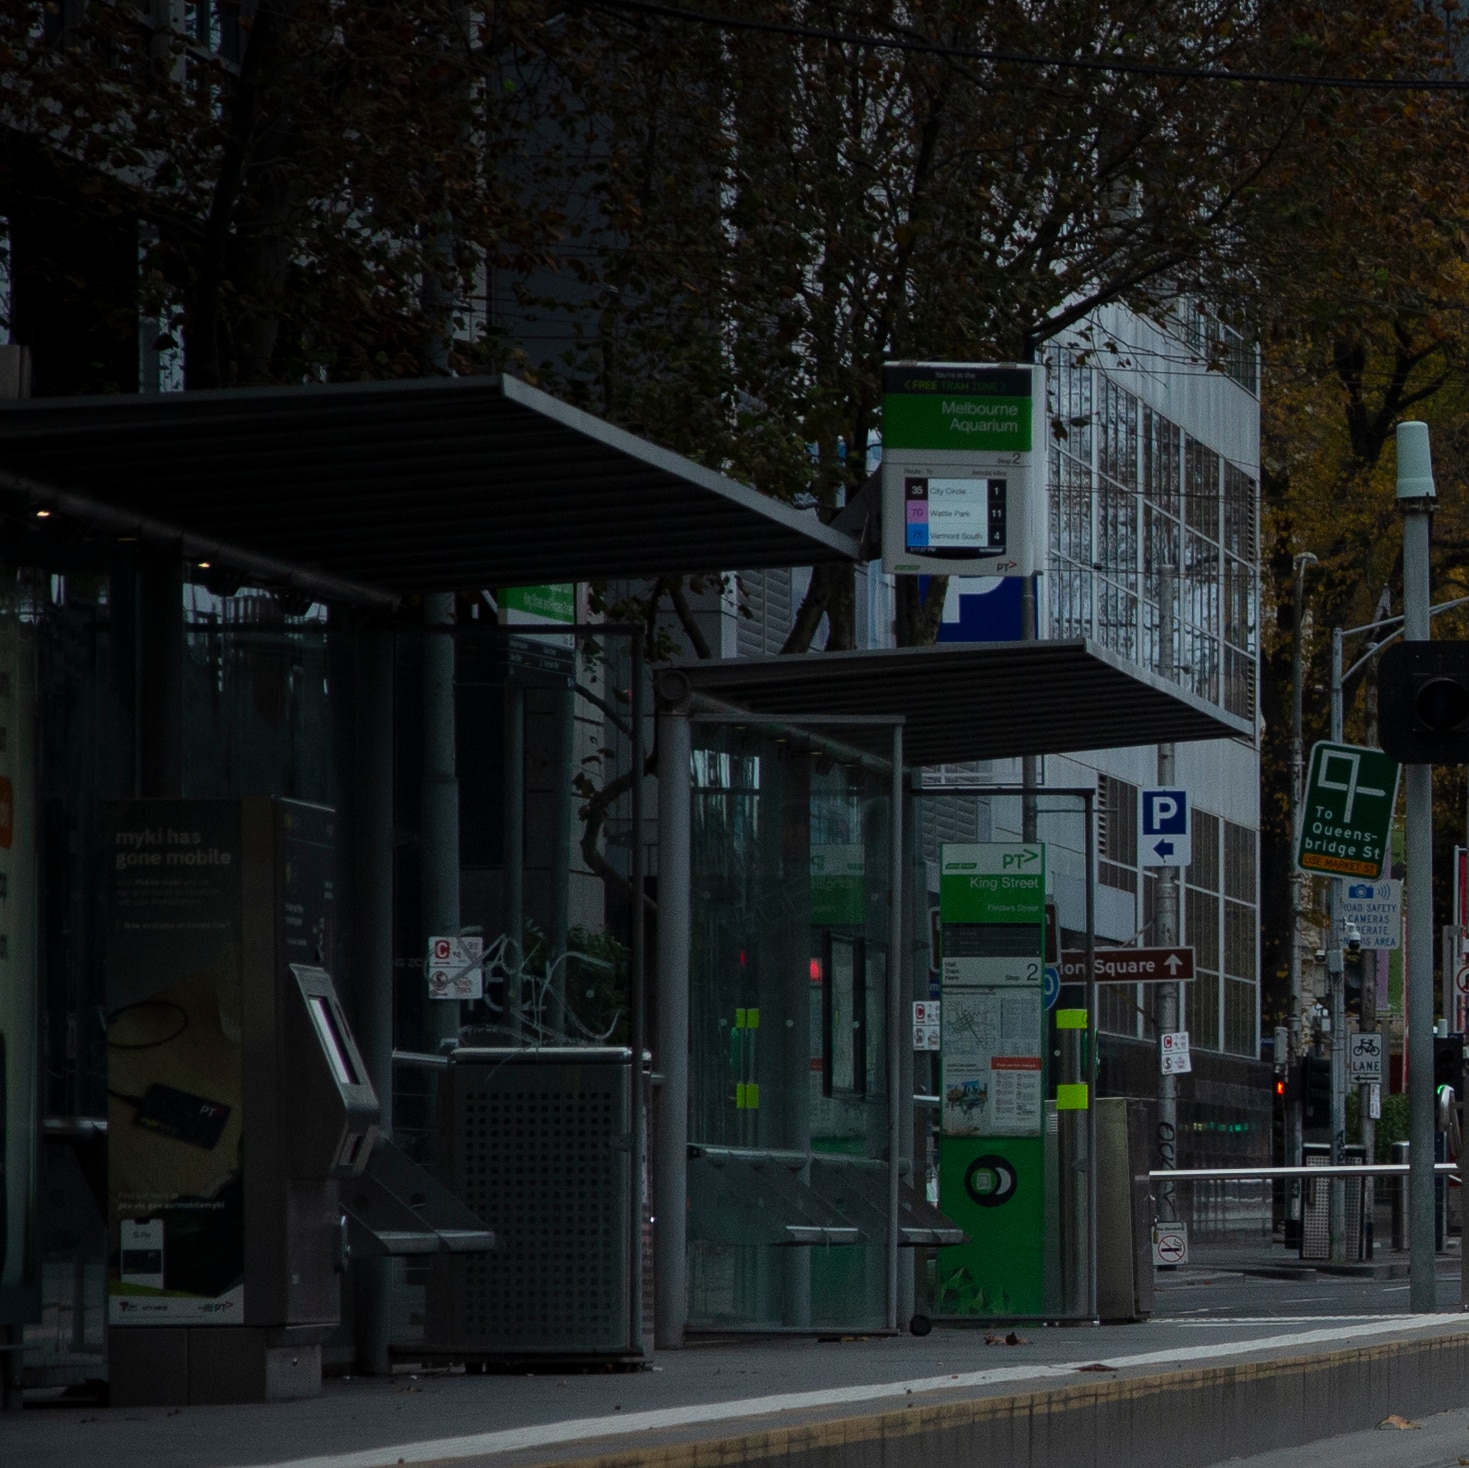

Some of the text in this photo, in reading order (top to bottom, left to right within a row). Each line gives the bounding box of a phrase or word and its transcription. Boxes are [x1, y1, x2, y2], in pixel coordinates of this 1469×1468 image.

[912, 380, 997, 391] FREE TRAM ZONE
[942, 401, 1019, 416] Melbourne
[949, 417, 1019, 434] Aquarium
[1012, 453, 1021, 465] 2
[911, 485, 923, 495] 35
[929, 487, 966, 497] City Circle
[994, 486, 1000, 496] 1
[912, 508, 923, 517] 70
[930, 510, 952, 518] Wattle
[991, 509, 1002, 518] 11
[930, 532, 959, 540] Vermont
[993, 531, 1001, 541] 4
[1152, 796, 1178, 830] P
[1315, 805, 1334, 820] To
[1311, 822, 1379, 842] Queens-
[116, 828, 202, 849] myki has
[1304, 837, 1381, 860] bridge St
[115, 848, 232, 870] gone mobile
[1325, 856, 1362, 872] MARKET
[1363, 862, 1376, 874] ST
[969, 877, 1039, 891] King Street
[1366, 904, 1397, 913] SAFETY
[1347, 914, 1390, 924] CAMERAS
[1375, 937, 1396, 946] AREA
[1027, 963, 1038, 981] 2
[1094, 959, 1156, 977] Square
[1353, 1061, 1380, 1072] LANE
